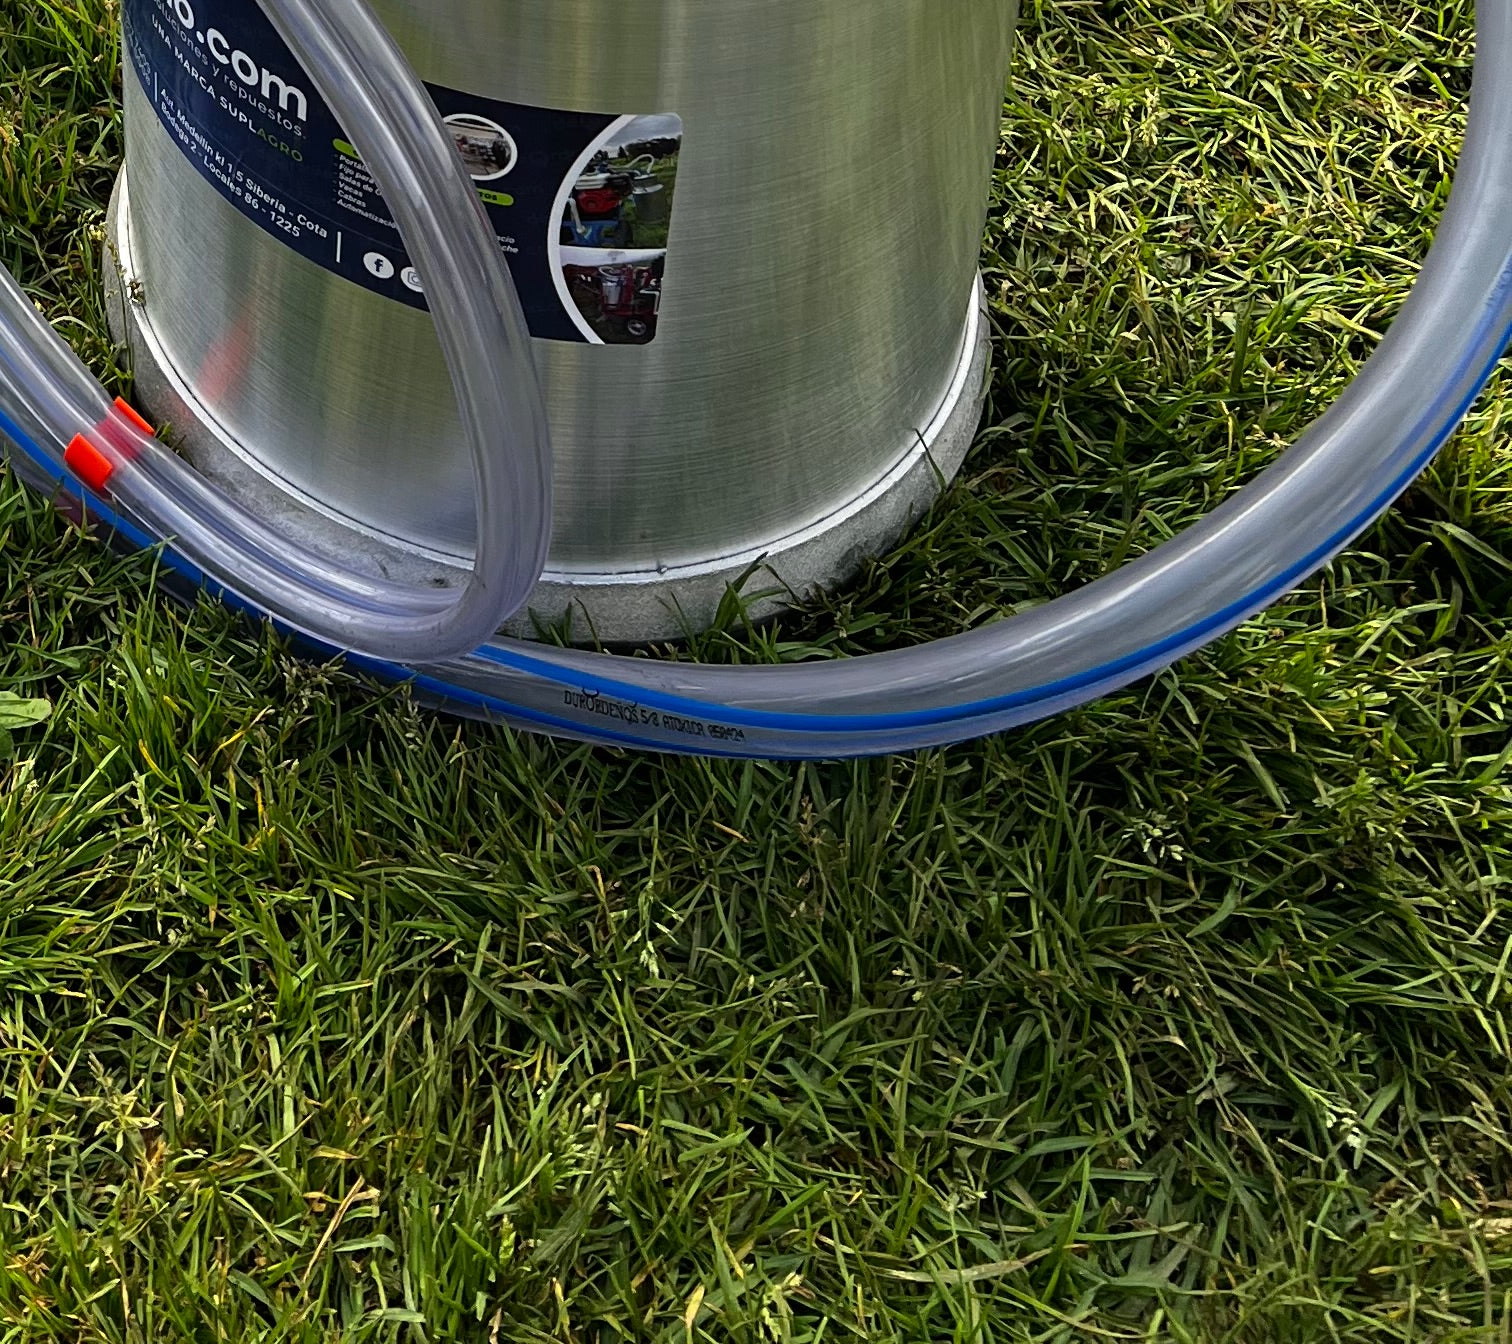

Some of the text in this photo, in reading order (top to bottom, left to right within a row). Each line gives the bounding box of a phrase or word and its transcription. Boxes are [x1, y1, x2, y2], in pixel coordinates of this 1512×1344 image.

[151, 13, 173, 50] UNA
[174, 46, 217, 100] MARCA
[219, 96, 304, 163] SUPLAGRO
[211, 62, 220, 78] y
[161, 101, 189, 145] Bodega
[190, 140, 197, 154] 2
[203, 155, 243, 196] Locales
[244, 191, 259, 210] 86
[269, 211, 301, 238] 1225
[246, 177, 286, 214] Siberia
[296, 213, 328, 239] Cota
